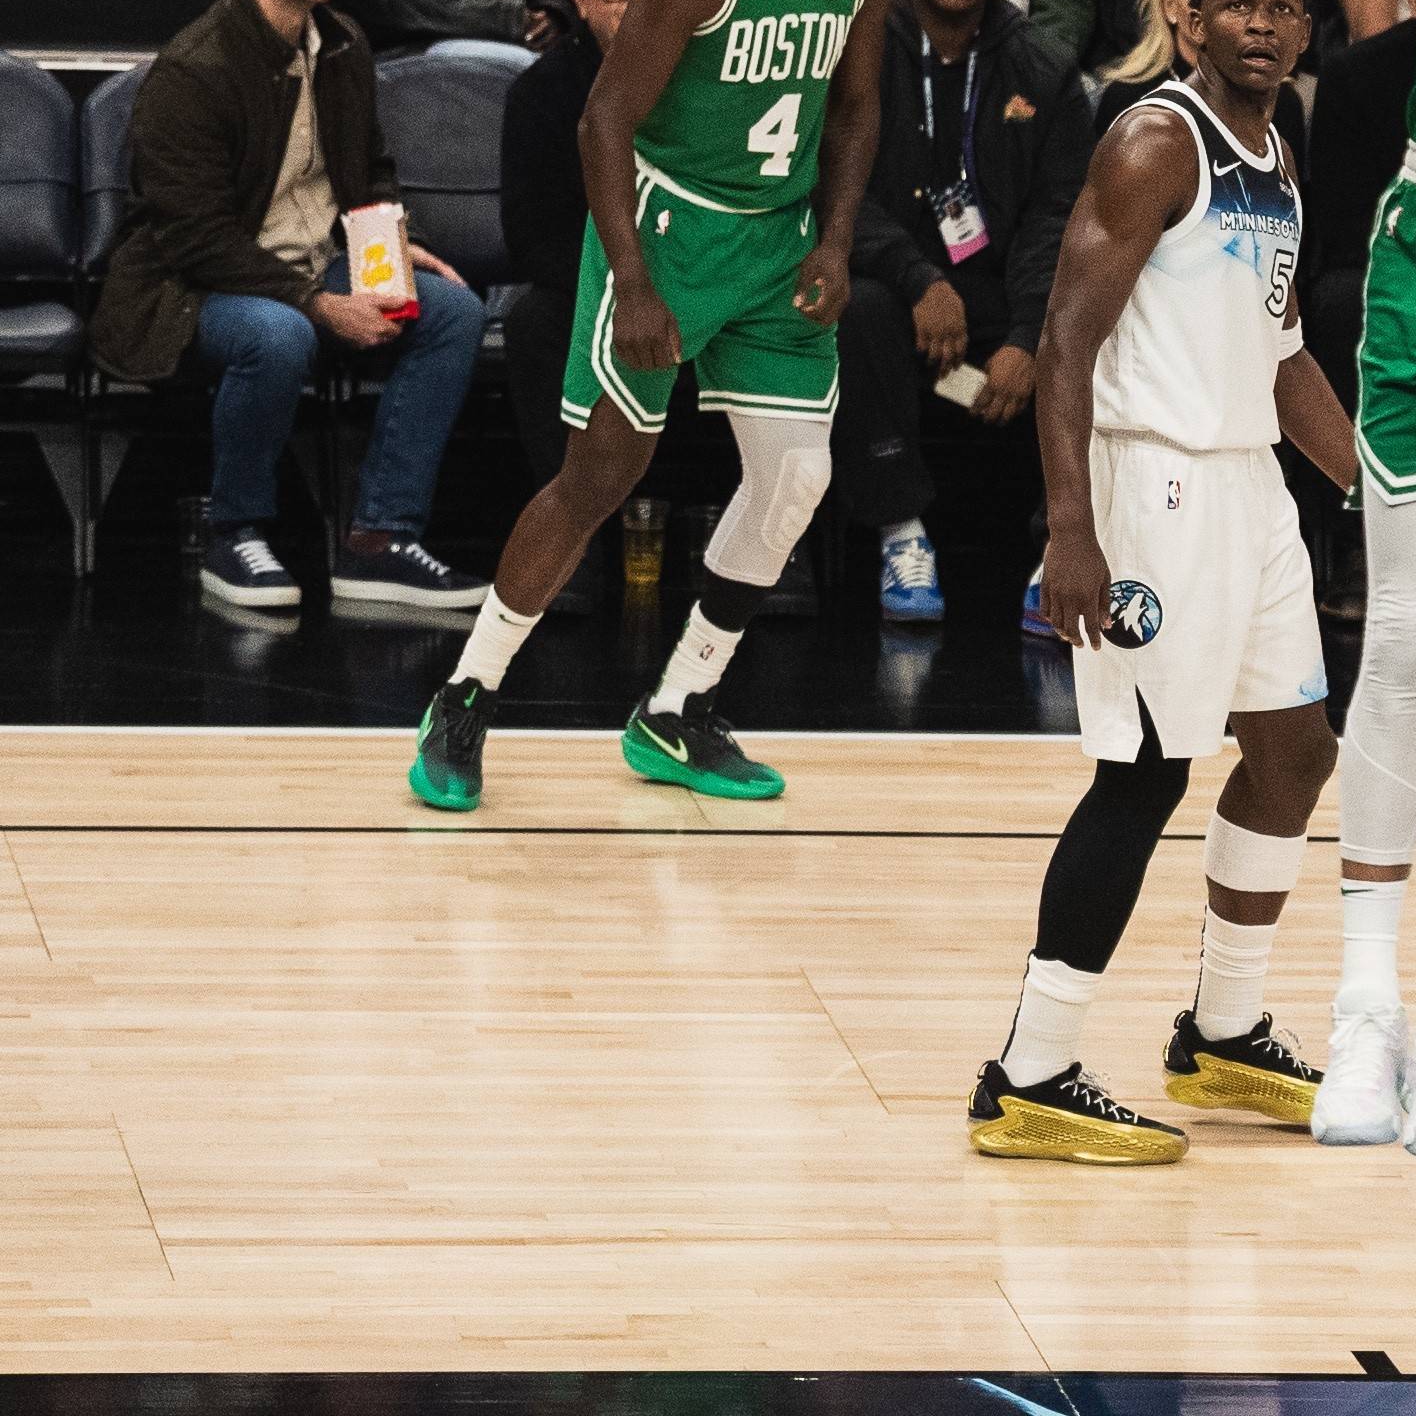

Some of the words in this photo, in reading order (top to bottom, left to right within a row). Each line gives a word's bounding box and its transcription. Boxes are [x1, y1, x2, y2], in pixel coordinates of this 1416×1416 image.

[719, 12, 853, 84] BOSTON
[747, 93, 803, 177] 4
[1264, 248, 1295, 319] 5
